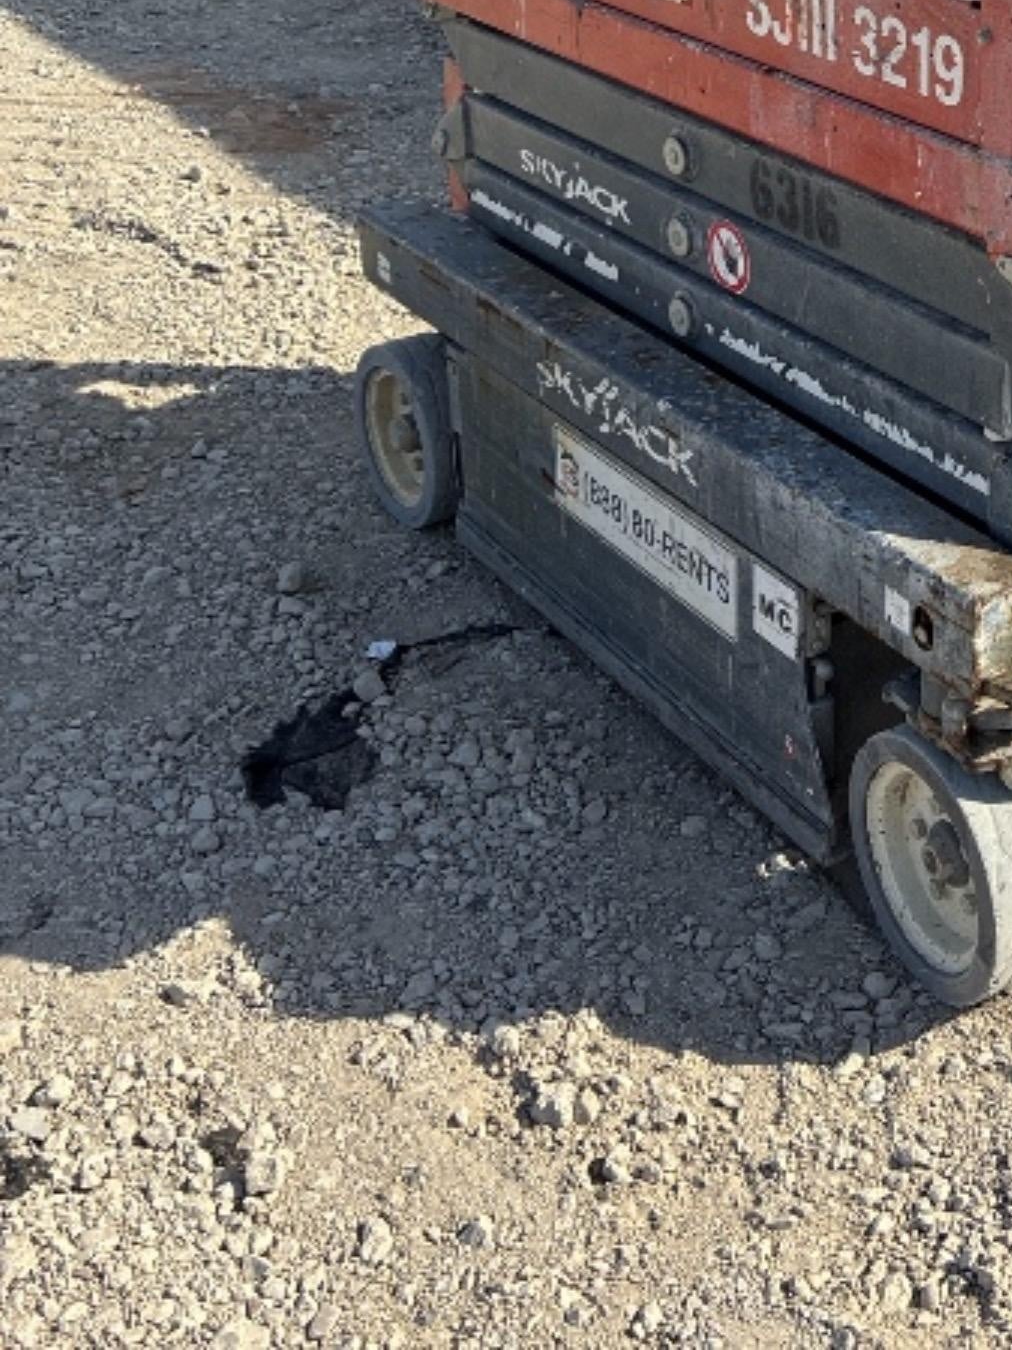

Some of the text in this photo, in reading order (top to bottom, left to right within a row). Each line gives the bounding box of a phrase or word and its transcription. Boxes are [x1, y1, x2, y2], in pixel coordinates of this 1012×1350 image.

[852, 5, 965, 106] 3219
[519, 149, 631, 225] SKYJACK
[753, 157, 841, 250] 6316
[536, 361, 698, 487] SKYJACK
[758, 593, 793, 632] MC
